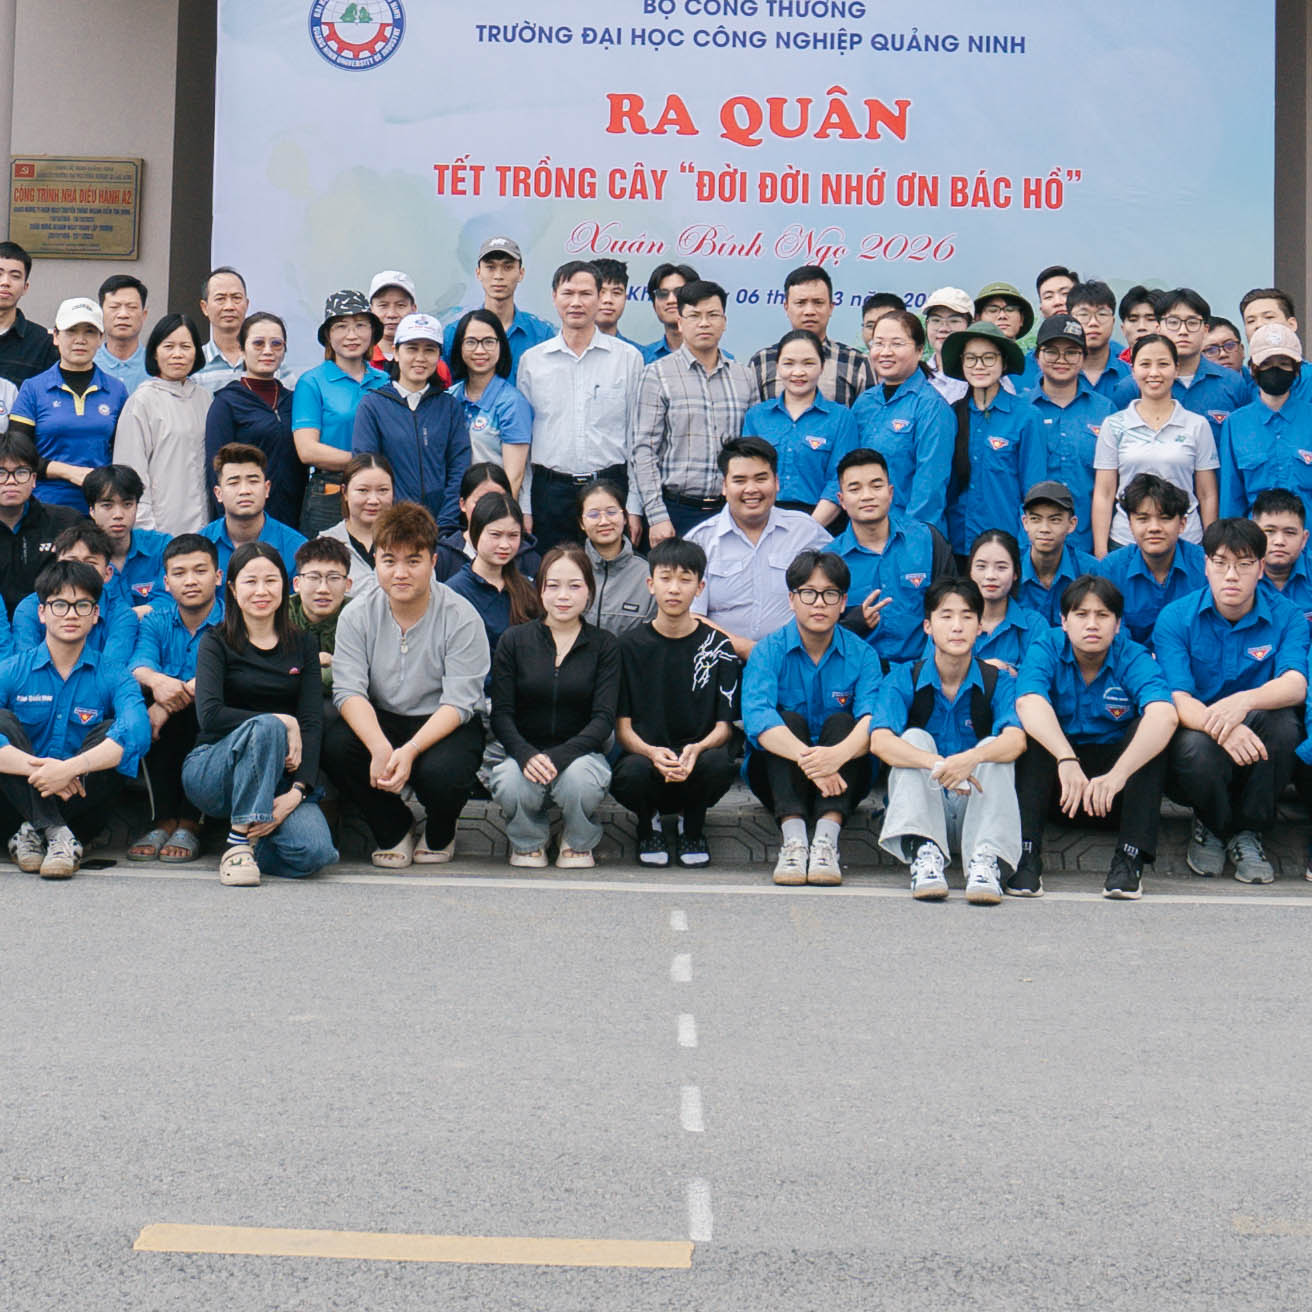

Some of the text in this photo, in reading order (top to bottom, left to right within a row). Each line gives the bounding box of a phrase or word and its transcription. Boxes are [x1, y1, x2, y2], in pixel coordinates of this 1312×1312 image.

[476, 21, 1027, 56] TRƯỜNG ĐẠI HỌC CÔNG NGHIỆP QUẢNG NINH
[606, 85, 911, 147] RA QUÂN
[434, 154, 484, 196] TẾT
[496, 155, 597, 199] TRỒNG
[608, 165, 668, 201] CÂY
[758, 165, 810, 205] ĐỜI
[821, 167, 887, 206] NHỚ
[897, 172, 939, 207] ƠN
[950, 169, 1012, 208] BÁC
[567, 221, 957, 268] Xuân Bính Ngọ 2026
[627, 286, 652, 301] Kh
[735, 289, 760, 304] 06
[904, 292, 928, 308] 20
